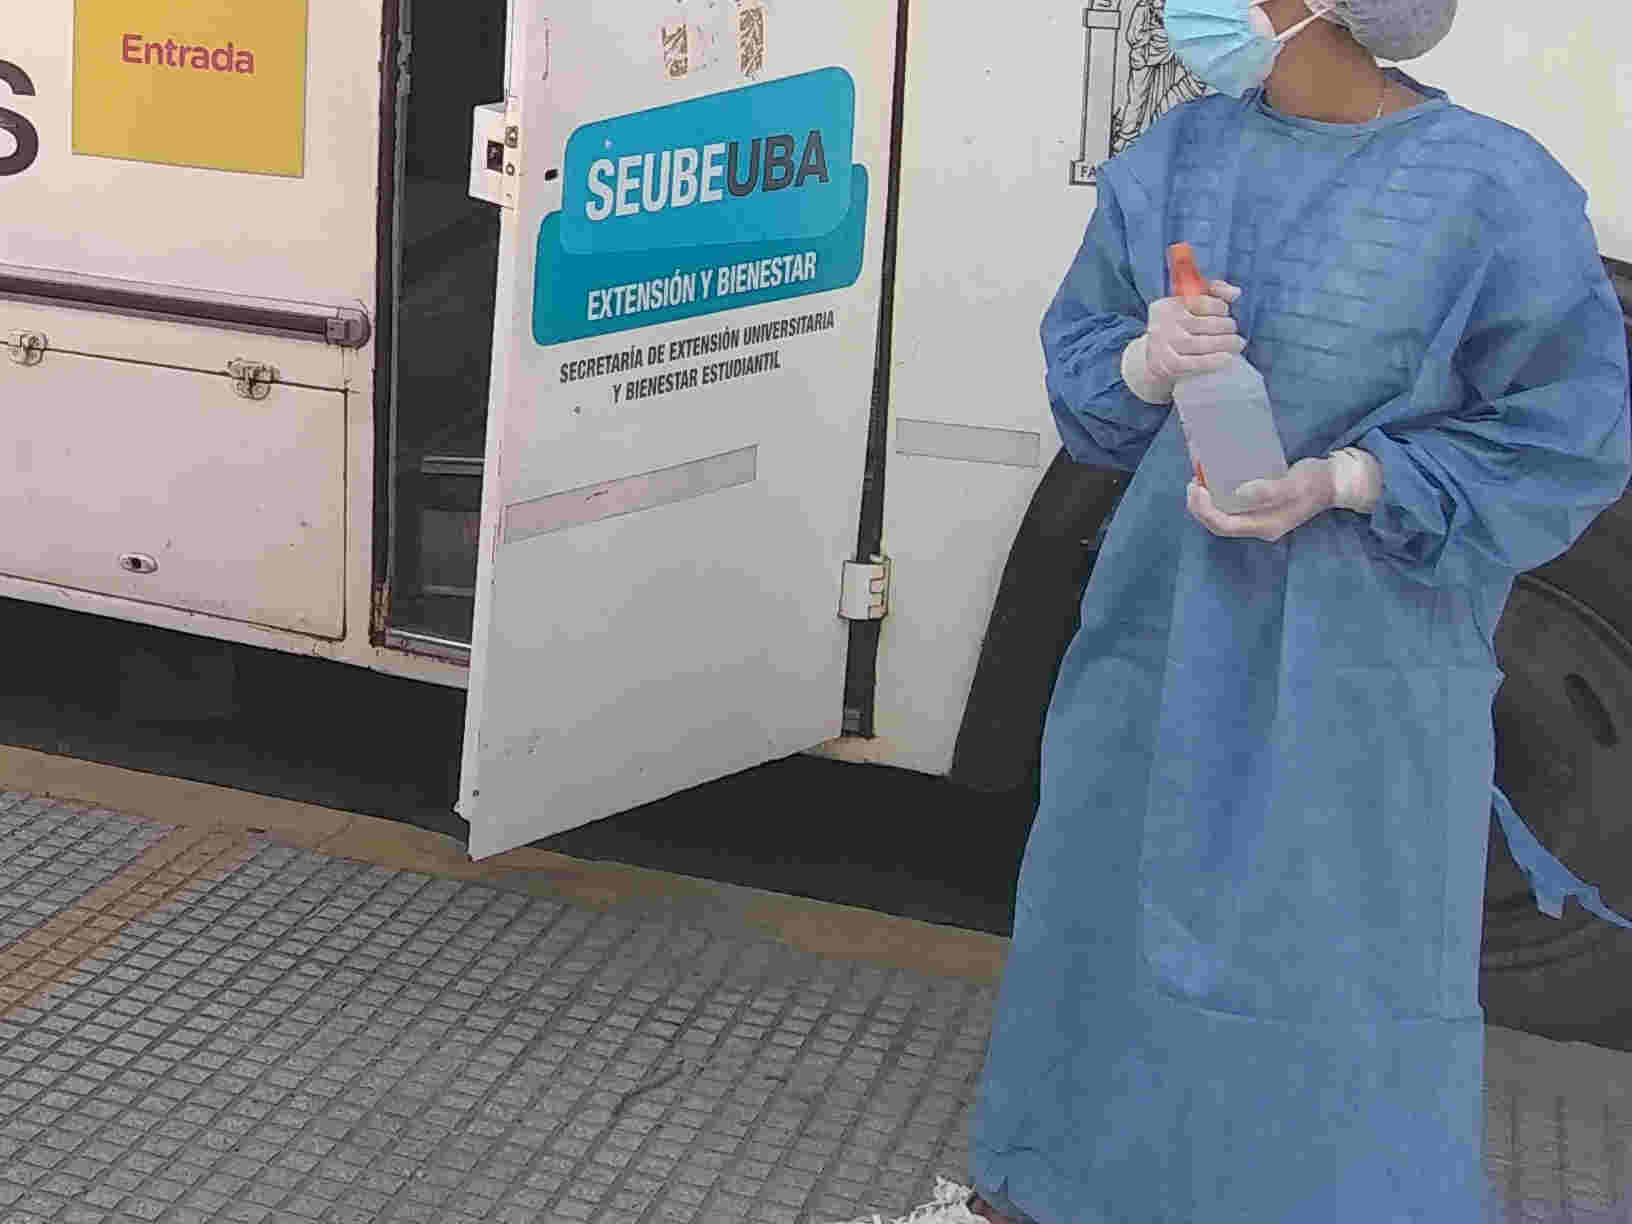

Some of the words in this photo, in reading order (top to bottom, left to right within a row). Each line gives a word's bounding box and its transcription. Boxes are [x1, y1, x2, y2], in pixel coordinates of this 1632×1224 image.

[121, 33, 255, 75] Entrada
[587, 269, 696, 321] EXTENSIÓN
[700, 269, 714, 299] Y
[717, 251, 817, 297] BIENESTAR
[559, 345, 643, 384] SECRETARÍA
[647, 344, 665, 366] DE
[669, 326, 740, 362] EXTENSIÓN
[743, 310, 835, 346] UNIVERSITARIA
[612, 384, 622, 404] Y
[625, 369, 698, 401] BIENESTAR
[701, 350, 782, 385] ESTUDIANTIL
